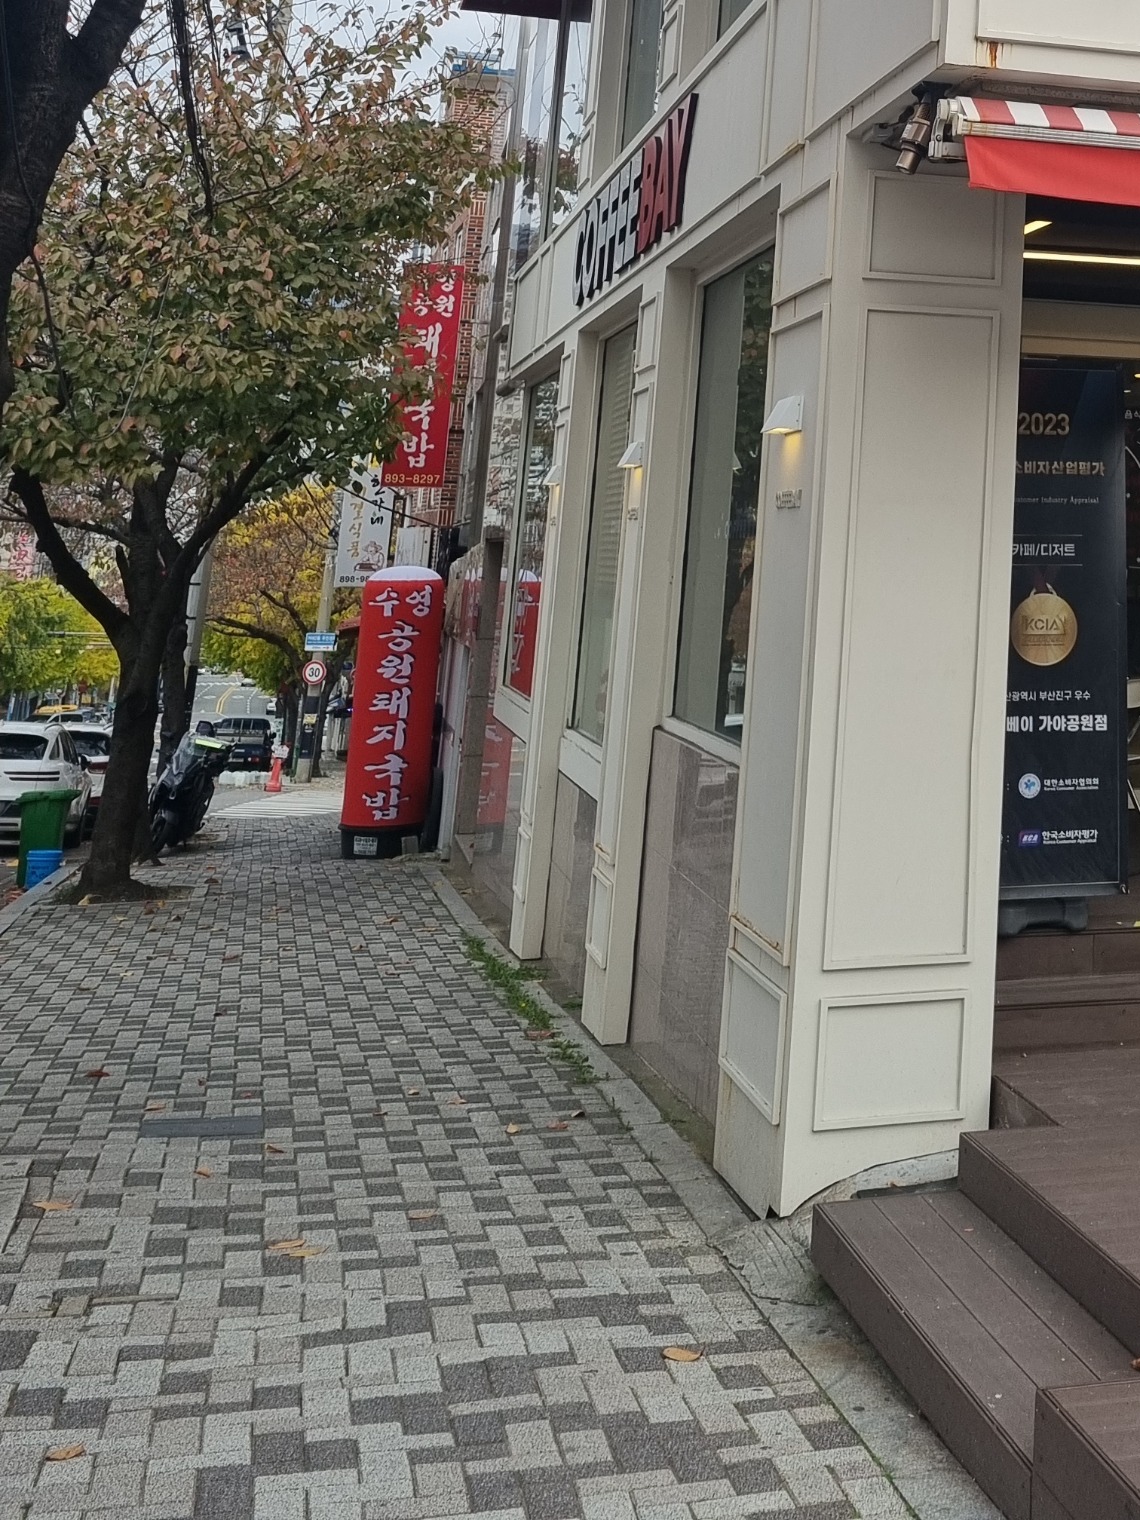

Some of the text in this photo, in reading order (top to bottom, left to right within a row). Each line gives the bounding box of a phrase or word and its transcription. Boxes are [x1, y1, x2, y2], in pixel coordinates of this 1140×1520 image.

[571, 92, 700, 306] COFFEEBAY
[1018, 412, 1070, 435] 2023
[384, 473, 441, 485] 893-8297
[1012, 543, 1076, 557] 카페/디저트
[368, 584, 433, 617] 수영
[1024, 618, 1061, 631] KCIA
[308, 667, 321, 678] 30
[1039, 690, 1072, 701] 부산진구
[1074, 690, 1091, 700] 우수
[1006, 714, 1108, 732] 베이 가야공원점
[1041, 829, 1098, 840] 한국소비자평가
